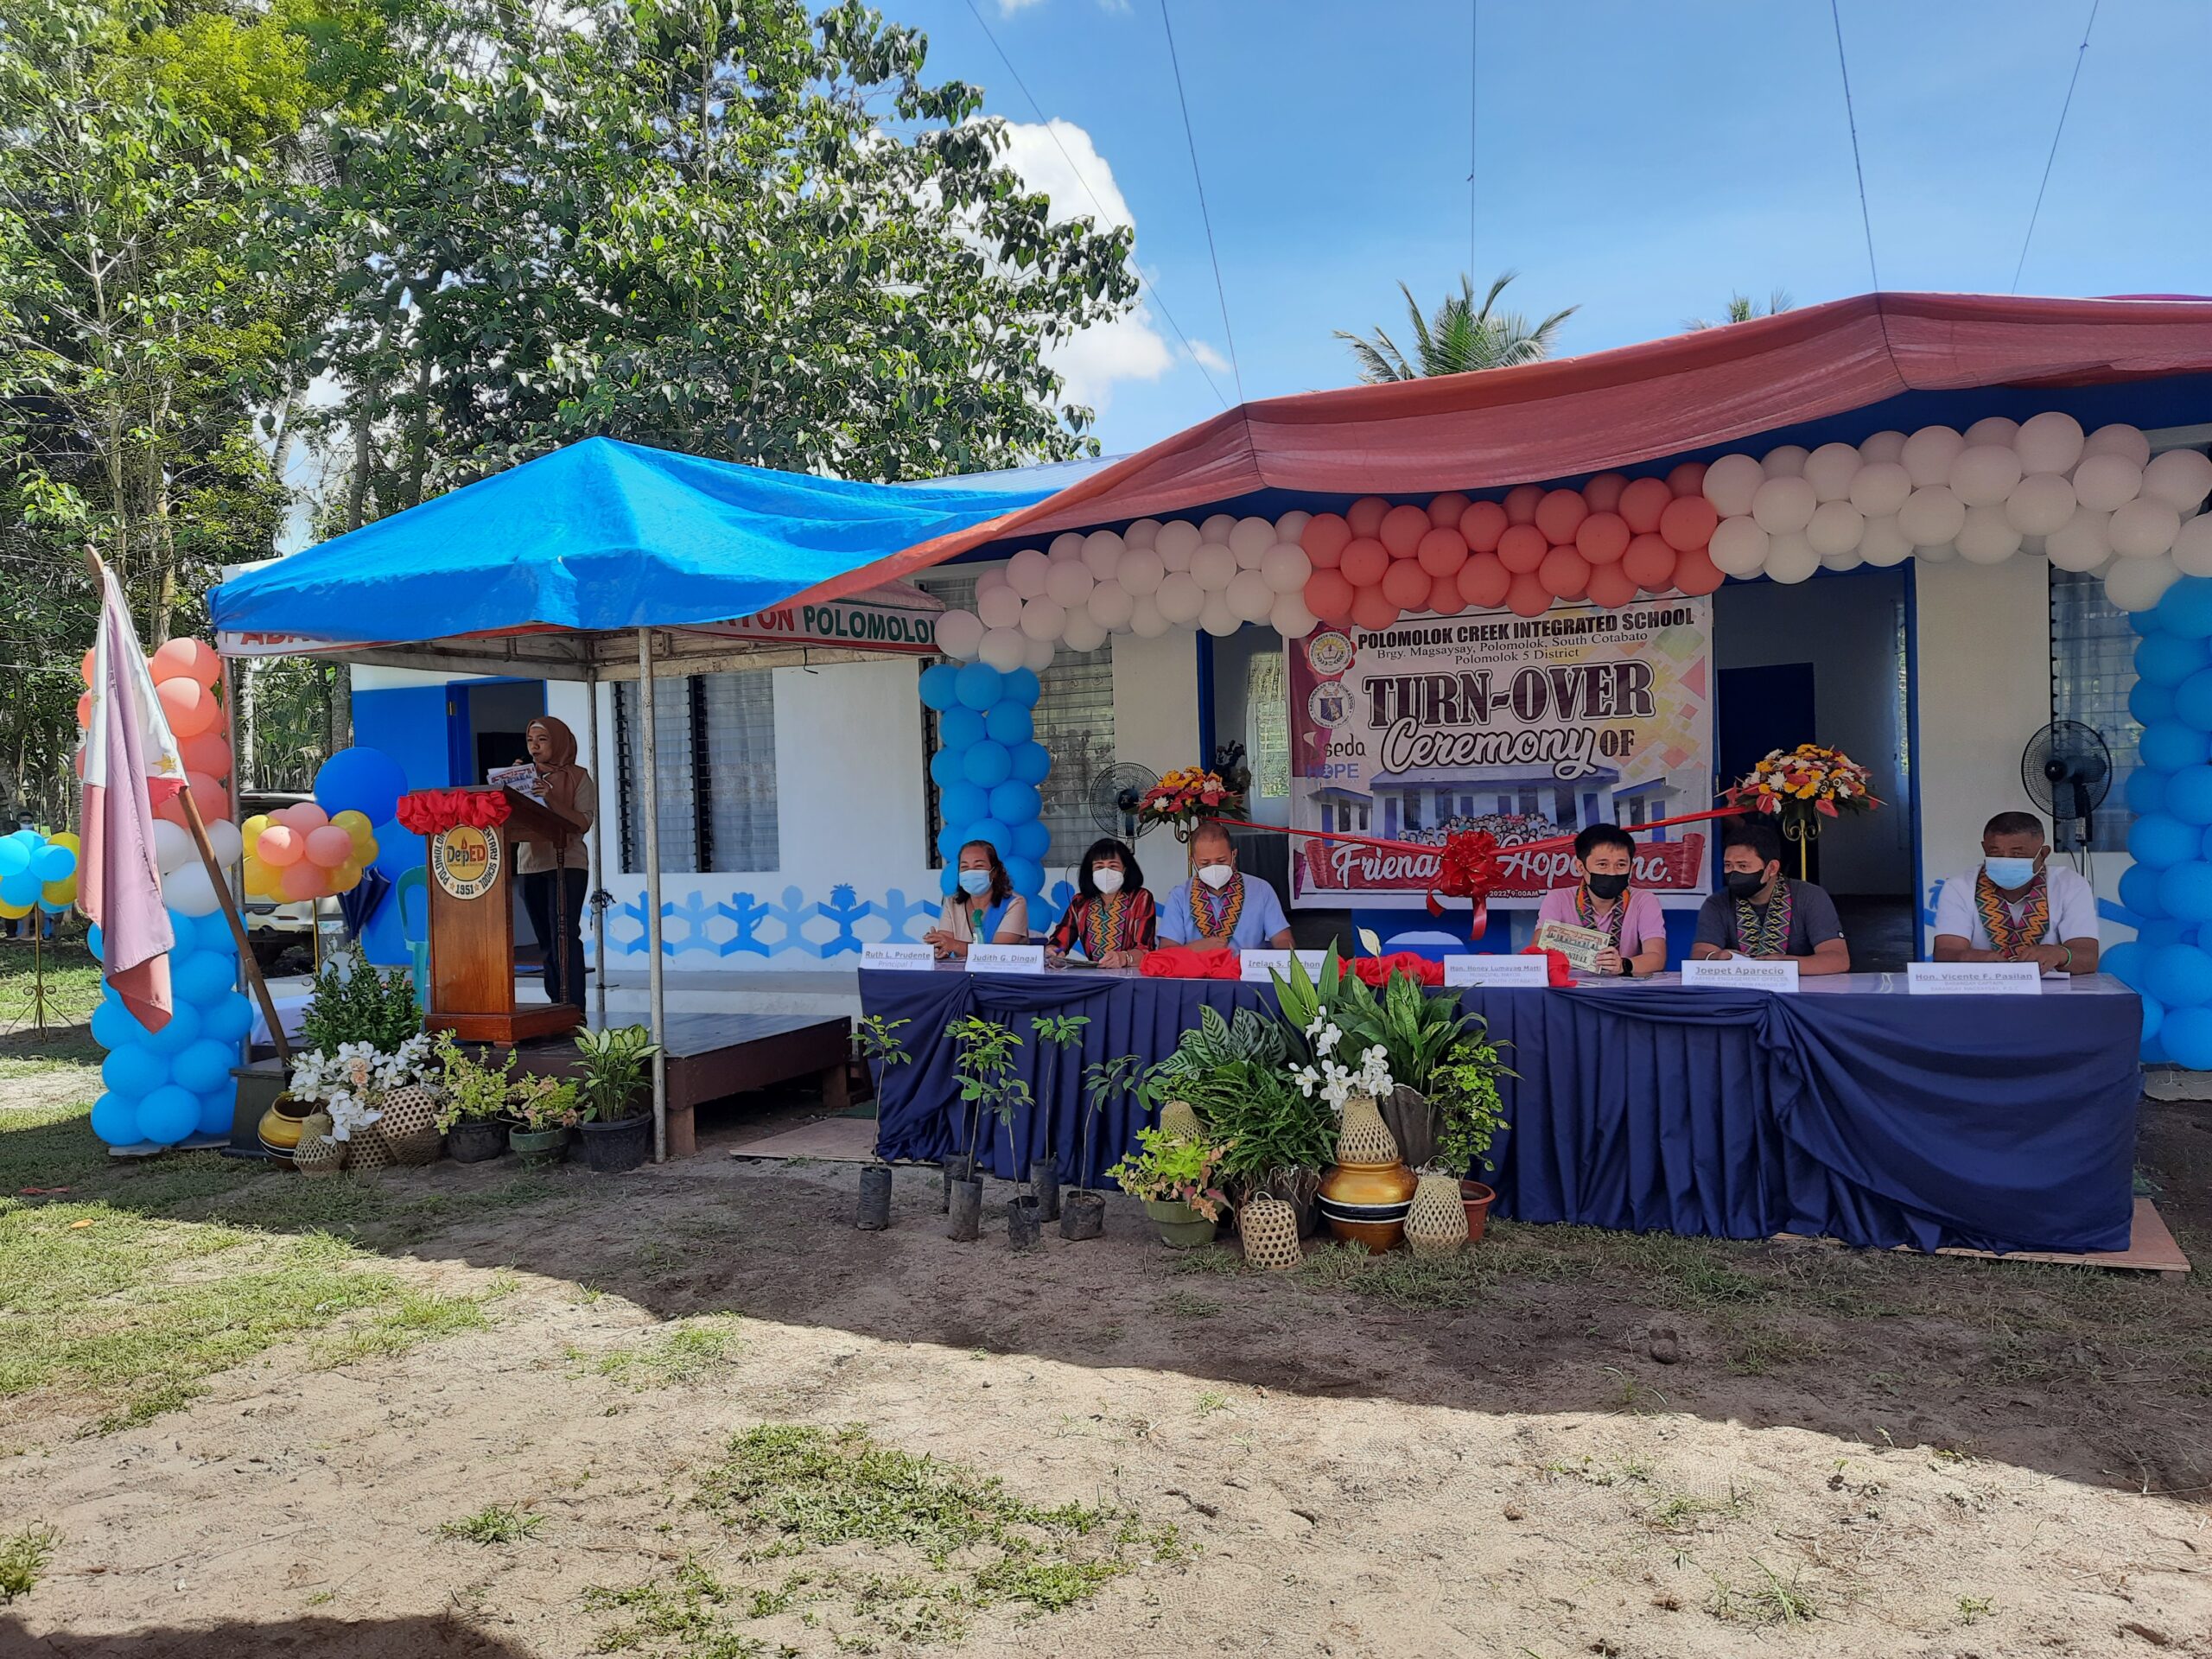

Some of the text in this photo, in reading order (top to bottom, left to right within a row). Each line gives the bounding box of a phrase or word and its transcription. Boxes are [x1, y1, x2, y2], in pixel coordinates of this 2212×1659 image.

[1358, 607, 1694, 649] POLOMOLOK CREEK INTEGRATED SCHOOL
[1377, 649, 1407, 660] Brgy.
[1410, 645, 1476, 658] Magsaysay,
[1552, 637, 1587, 647] South
[1592, 632, 1648, 644] Cotabato
[1455, 648, 1580, 664] Polomolok 5 District
[1363, 660, 1656, 729] TURN-OVER
[1325, 733, 1366, 757] seda
[1381, 715, 1635, 780] Ceremony OF
[1306, 763, 1359, 779] HOPE
[446, 844, 486, 867] DepED
[479, 863, 497, 889] SCHOOL
[455, 884, 474, 895] 1951
[1694, 967, 1732, 976] Joepet
